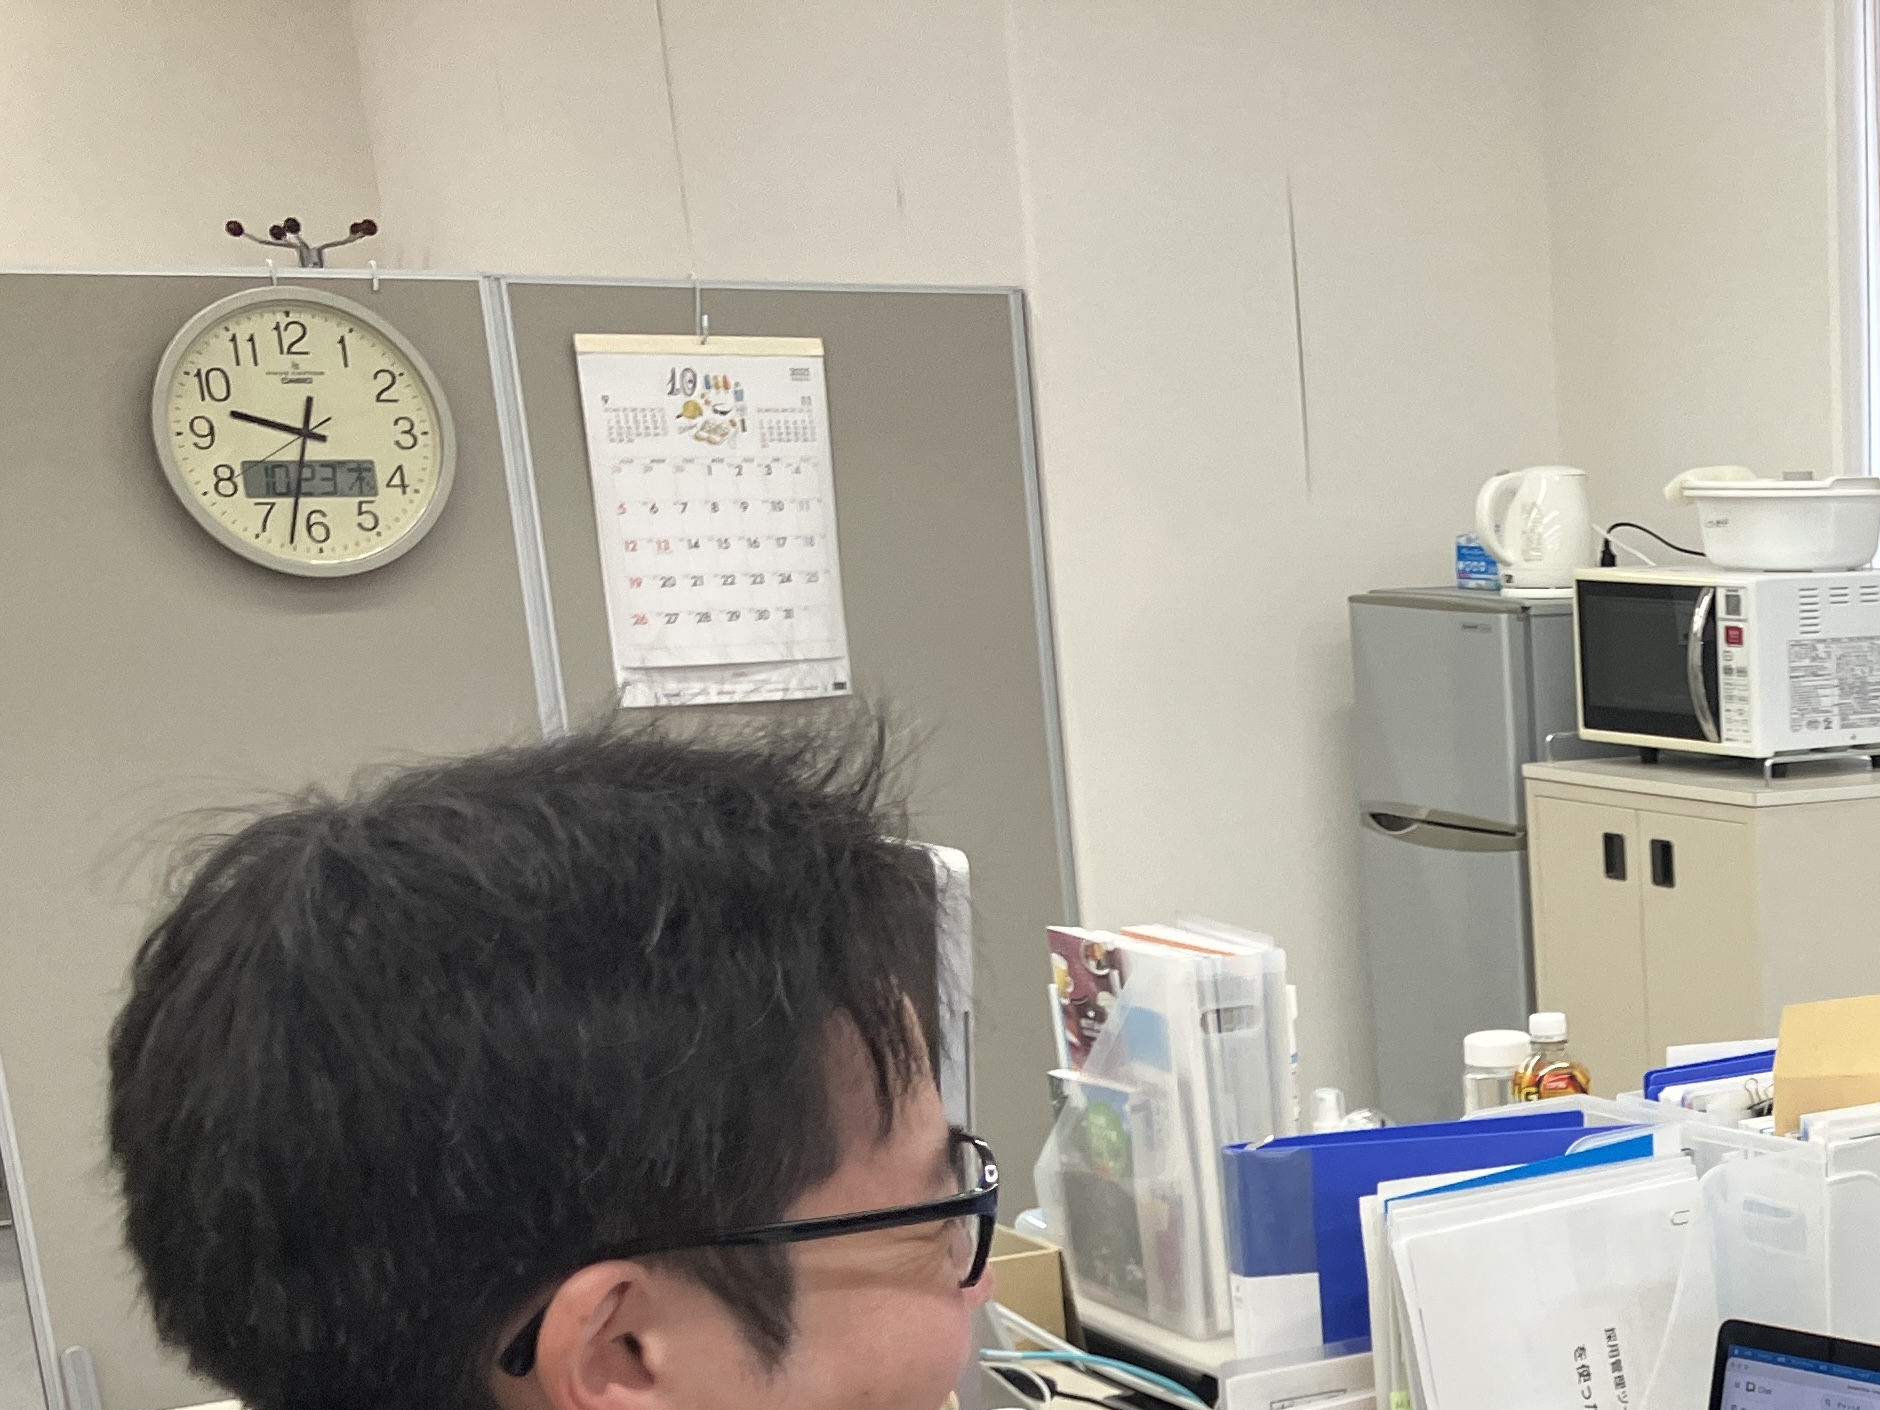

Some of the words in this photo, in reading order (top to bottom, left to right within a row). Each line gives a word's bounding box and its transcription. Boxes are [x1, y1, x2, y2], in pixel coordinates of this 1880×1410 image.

[229, 333, 258, 366] 11
[274, 320, 310, 355] 12
[337, 335, 349, 367] 1
[194, 366, 231, 402] 10
[373, 369, 400, 403] 2
[667, 367, 698, 397] 10
[189, 416, 216, 450] 9
[393, 416, 418, 450] 3
[213, 464, 238, 497] 8
[300, 464, 337, 495] 23
[385, 465, 410, 496] 4
[706, 464, 713, 476] 1
[735, 464, 744, 476] 2
[763, 464, 773, 476] 3
[254, 502, 277, 534] 7
[356, 500, 380, 531] 5
[617, 502, 627, 515] 5
[649, 502, 659, 515] 6
[679, 501, 689, 514] 7
[739, 501, 750, 513] 9
[306, 509, 331, 543] 6
